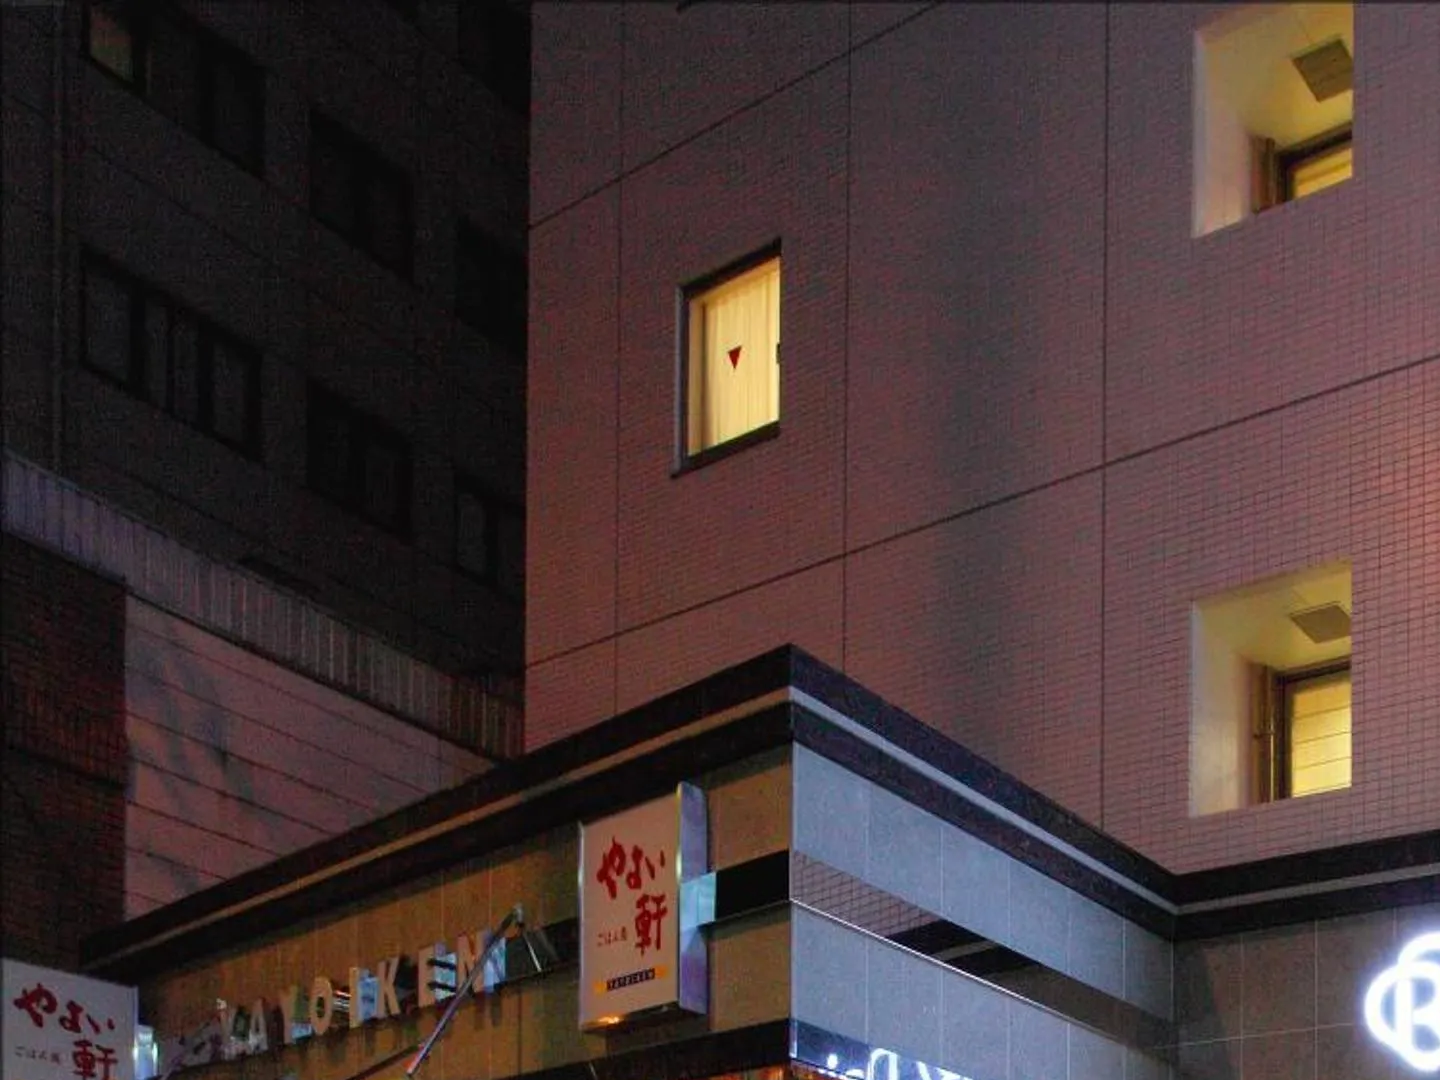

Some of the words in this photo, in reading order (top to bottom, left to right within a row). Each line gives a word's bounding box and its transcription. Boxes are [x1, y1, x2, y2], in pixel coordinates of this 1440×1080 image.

[597, 836, 666, 899] やよい
[14, 982, 115, 1034] やよい
